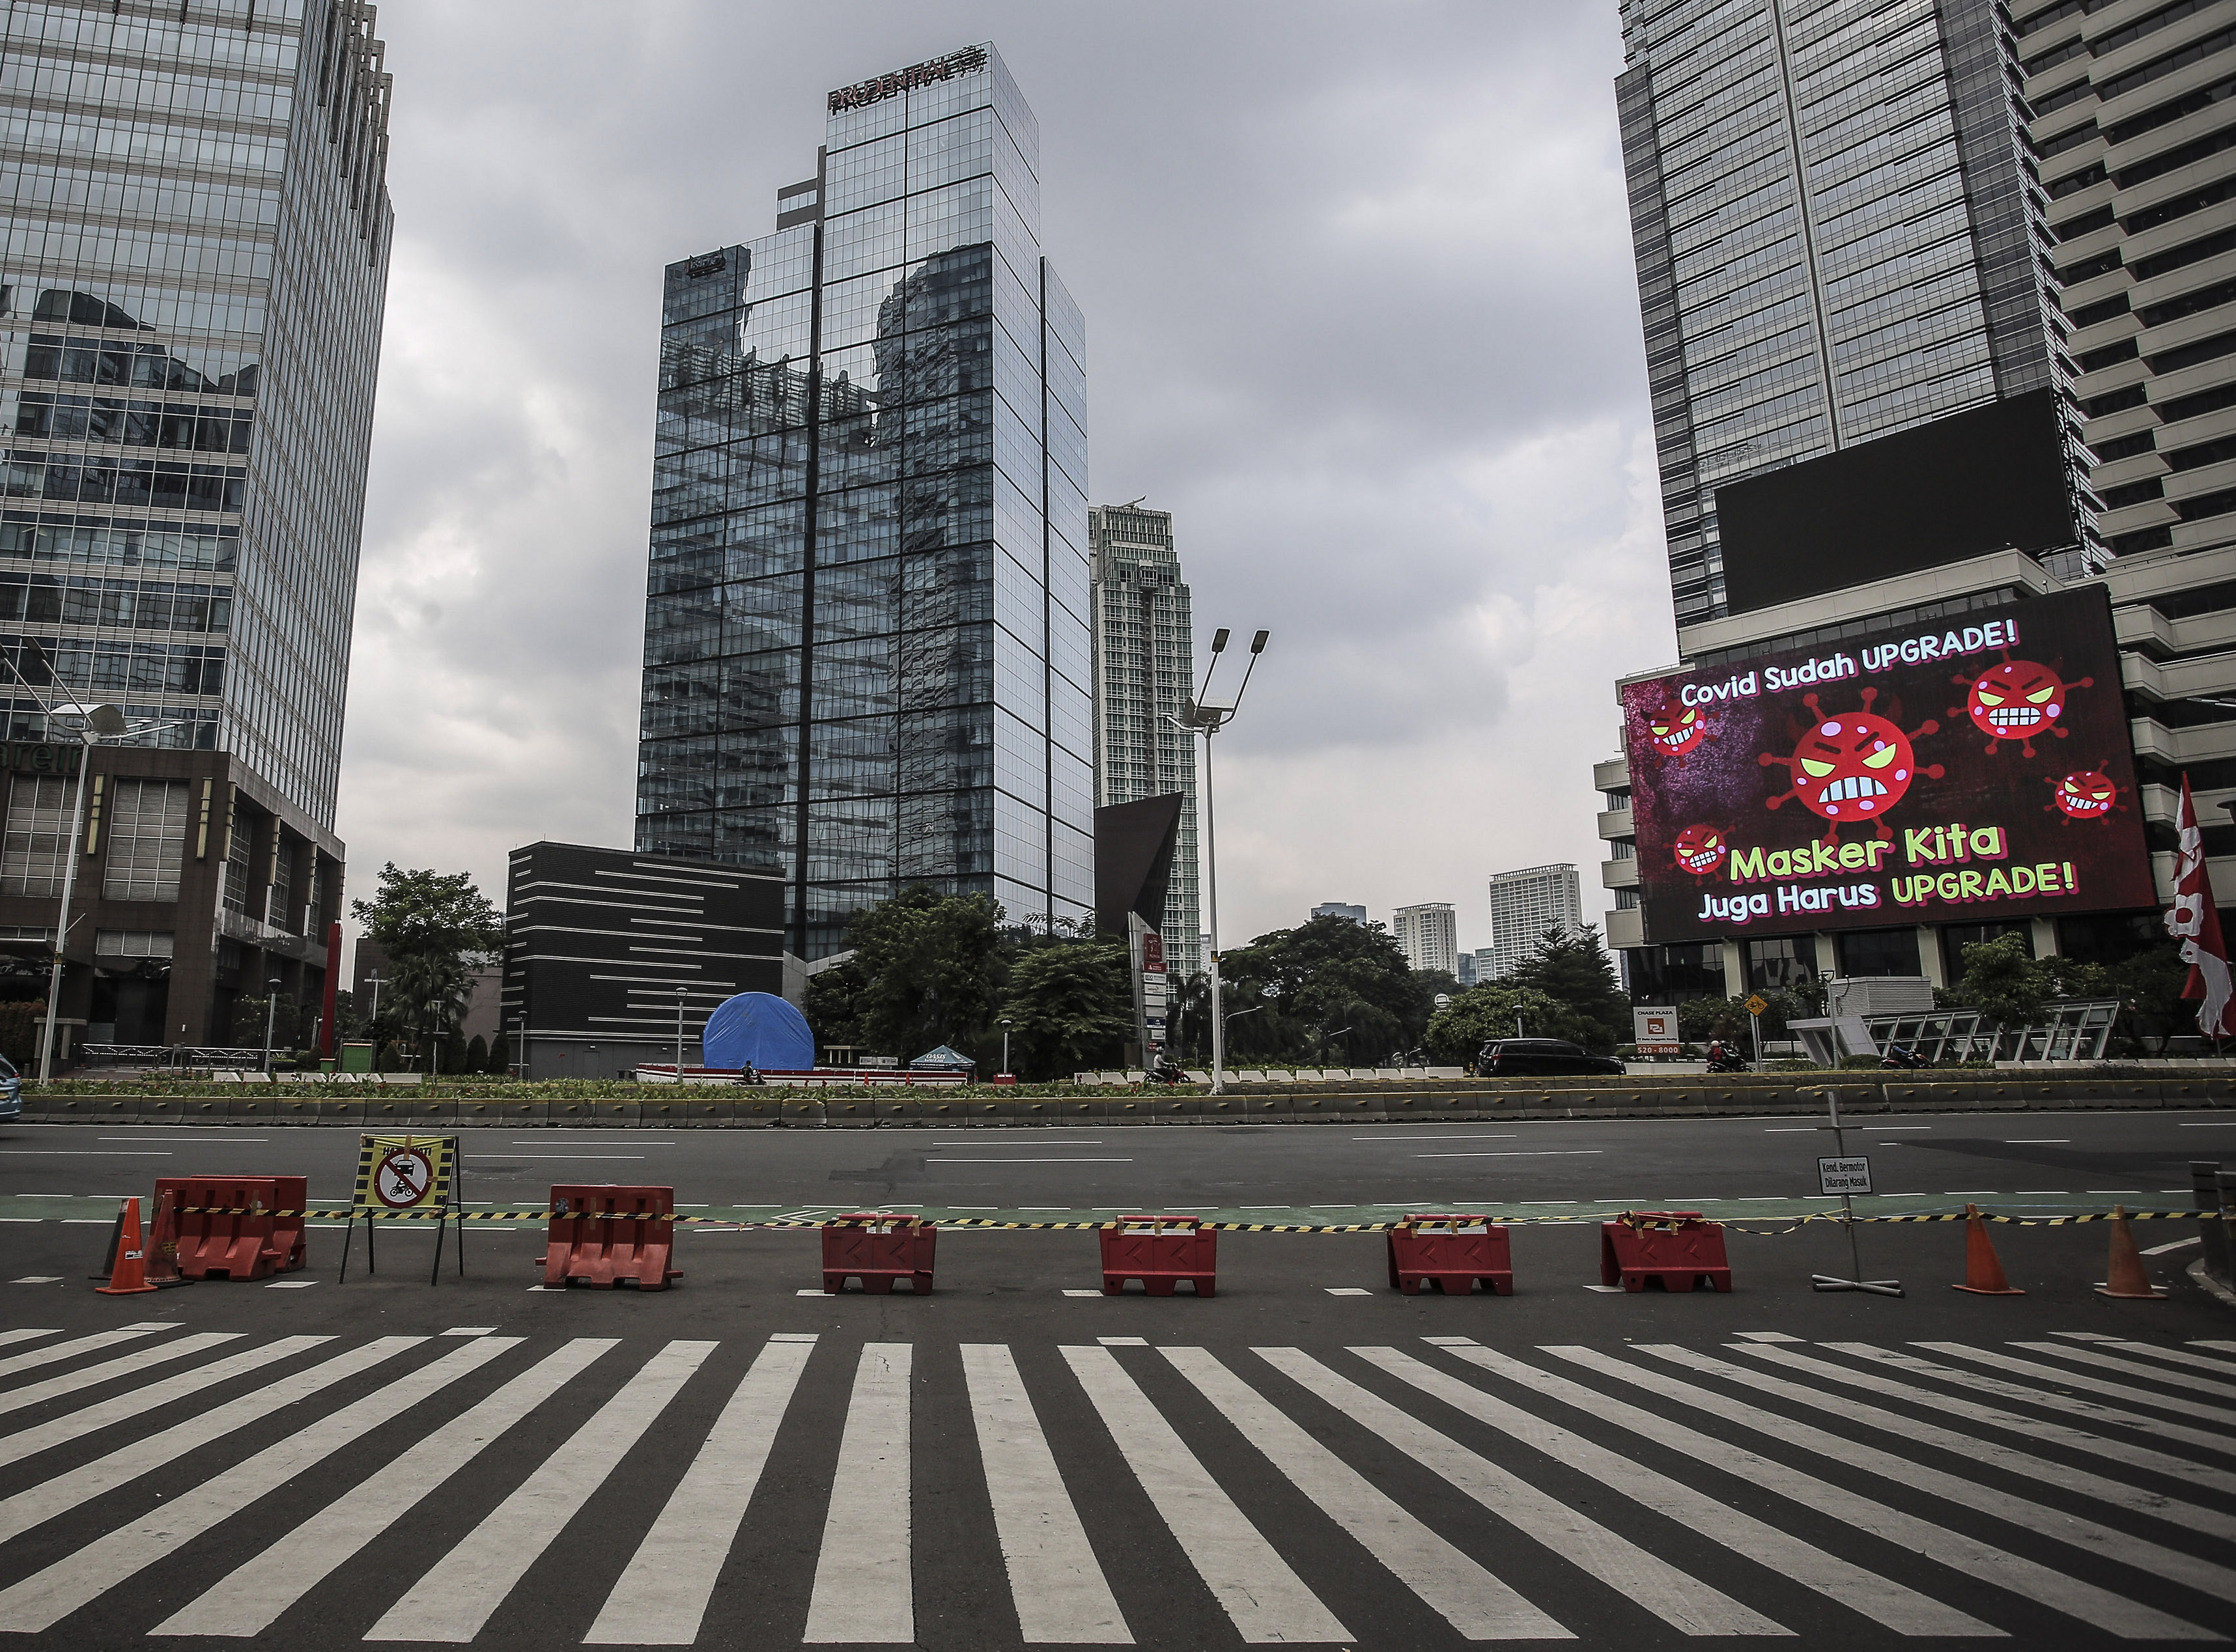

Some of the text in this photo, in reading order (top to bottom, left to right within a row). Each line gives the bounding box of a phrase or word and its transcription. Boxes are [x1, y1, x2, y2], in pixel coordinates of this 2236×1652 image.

[827, 57, 952, 111] PRUDENTIAL
[1680, 618, 2020, 708] Covid Sudah UPGRADE!
[1729, 822, 2006, 883] Masker Kita
[1697, 861, 2079, 923] Juga Harus UPGRADE!
[1822, 1162, 1865, 1173] Kend. Bermotor
[1825, 1176, 1867, 1190] Dilarang Masuk
